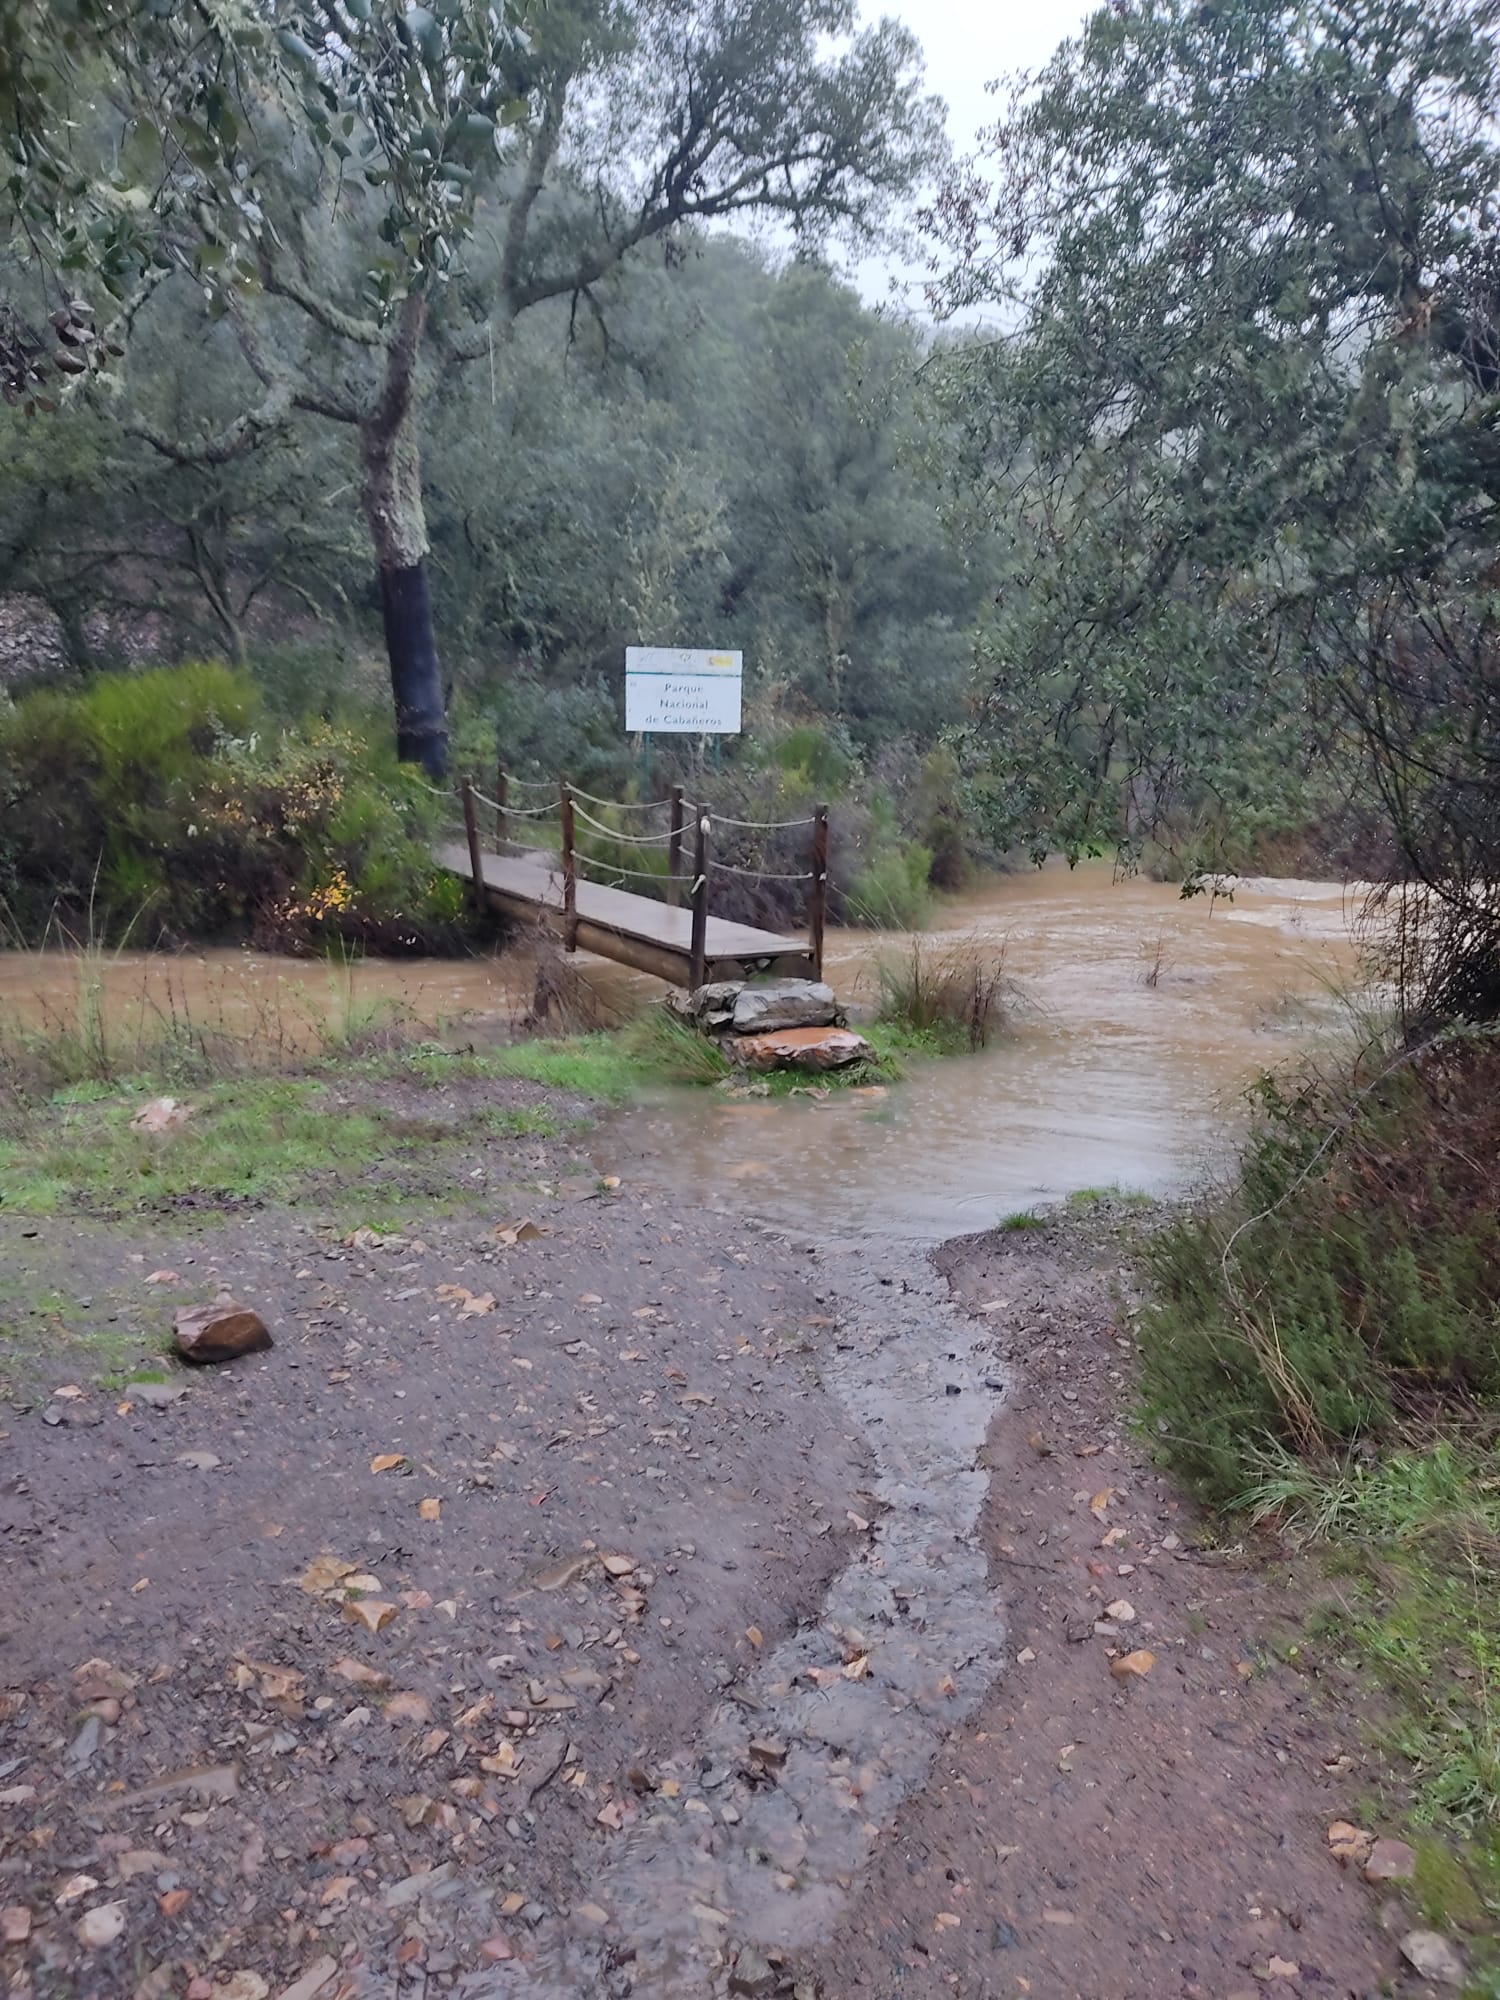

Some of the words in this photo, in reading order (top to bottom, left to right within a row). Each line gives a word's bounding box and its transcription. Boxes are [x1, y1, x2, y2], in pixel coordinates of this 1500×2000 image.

[664, 683, 703, 695] Parque
[660, 699, 709, 709] Nacional
[645, 714, 659, 724] de
